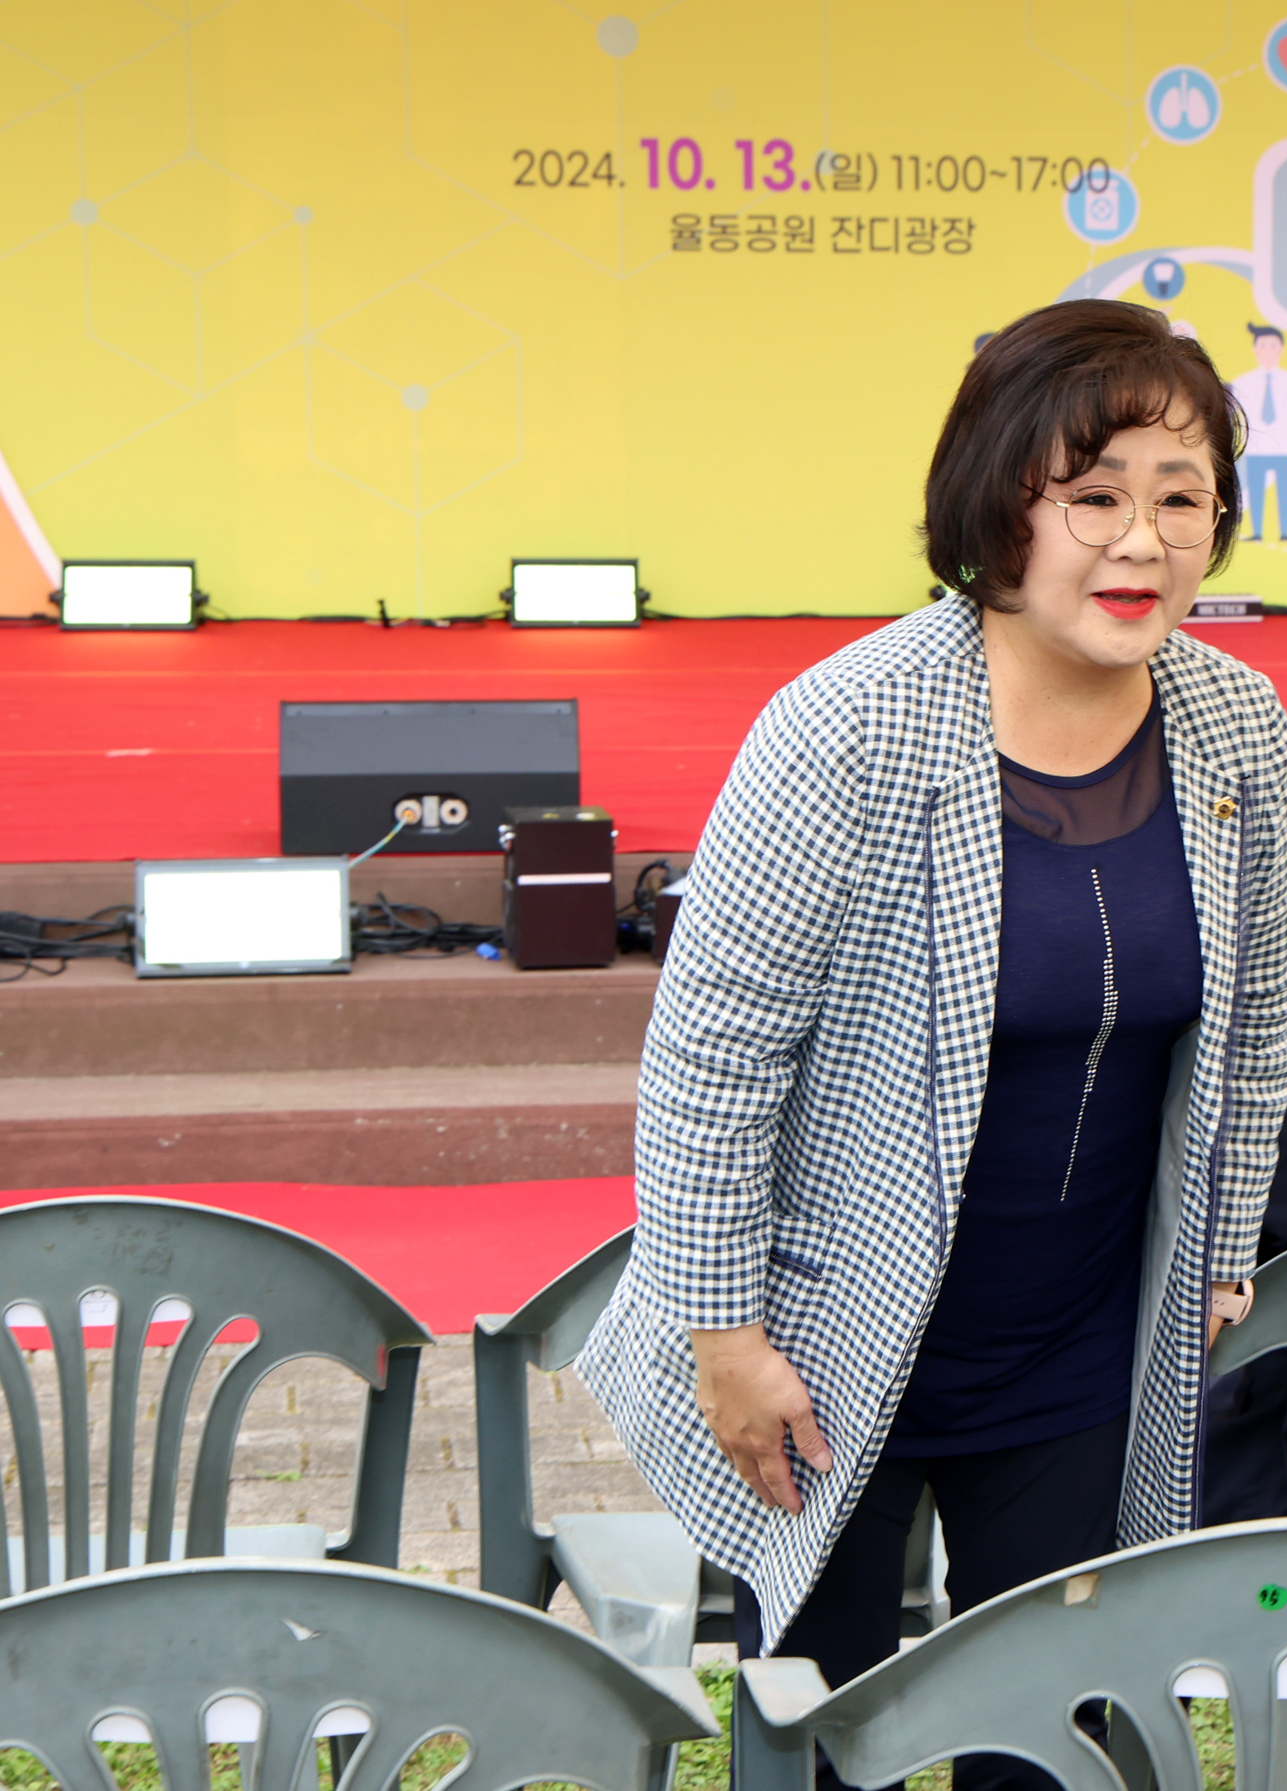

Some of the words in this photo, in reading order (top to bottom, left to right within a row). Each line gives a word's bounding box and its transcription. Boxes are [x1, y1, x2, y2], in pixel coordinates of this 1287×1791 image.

[511, 147, 626, 188] 2024.
[638, 136, 718, 192] 10.
[890, 154, 1113, 195] 11:00~17:00
[669, 213, 816, 254] 율동공원
[830, 215, 977, 256] 잔디광장
